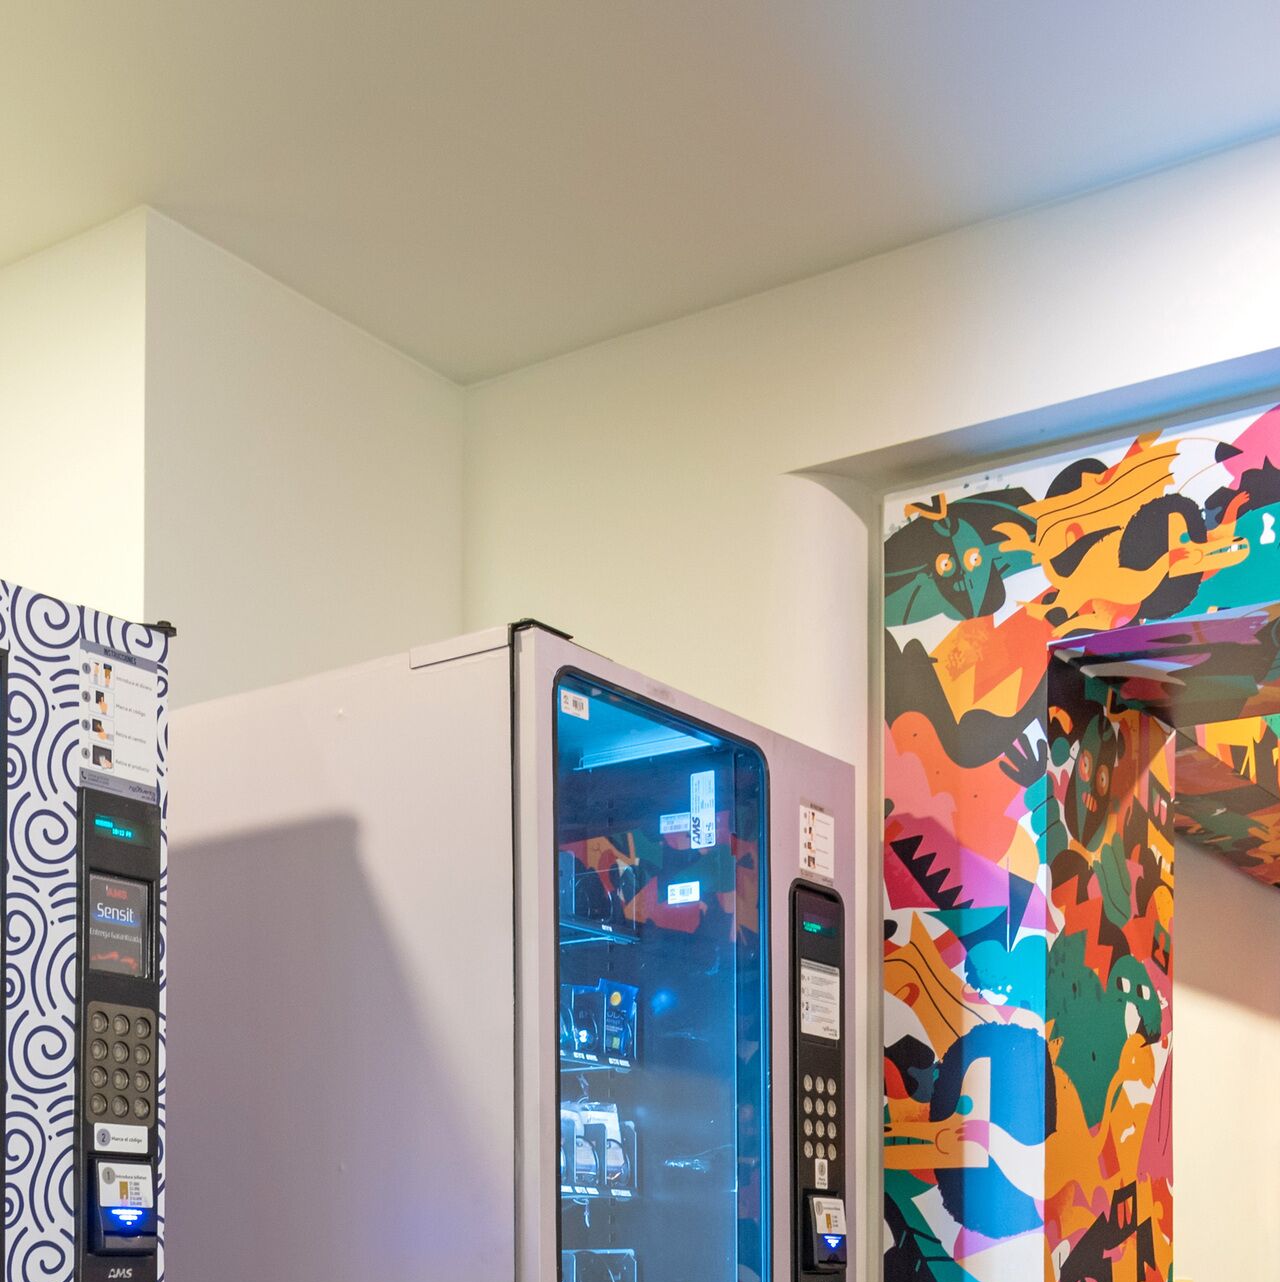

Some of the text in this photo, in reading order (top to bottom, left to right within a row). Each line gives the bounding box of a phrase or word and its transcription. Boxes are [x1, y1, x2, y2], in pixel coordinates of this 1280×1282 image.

[692, 816, 701, 845] AMS
[96, 902, 134, 923] Sensit
[108, 1268, 133, 1279] AMS
